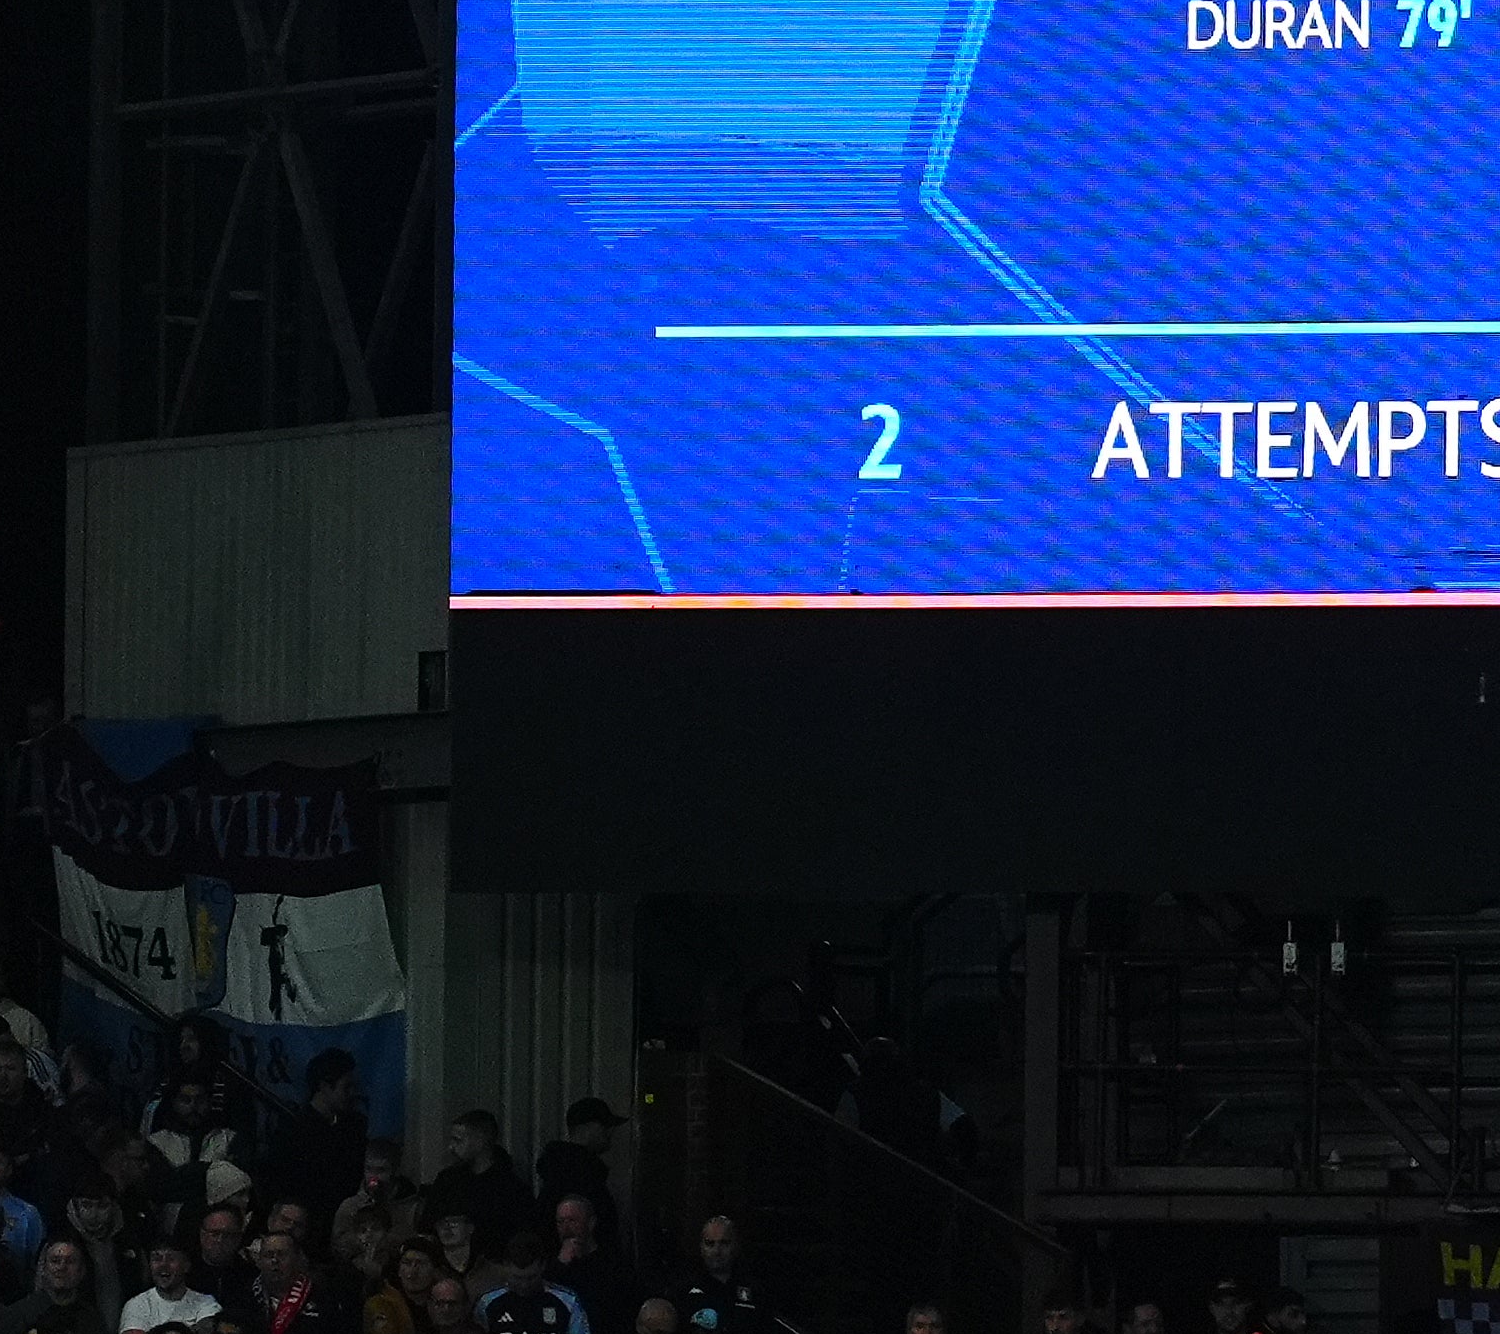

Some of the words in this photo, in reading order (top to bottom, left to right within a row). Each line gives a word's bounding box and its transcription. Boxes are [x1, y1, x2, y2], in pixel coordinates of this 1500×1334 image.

[858, 403, 902, 479] 2
[210, 789, 356, 860] VILLA
[92, 890, 177, 981] 1874
